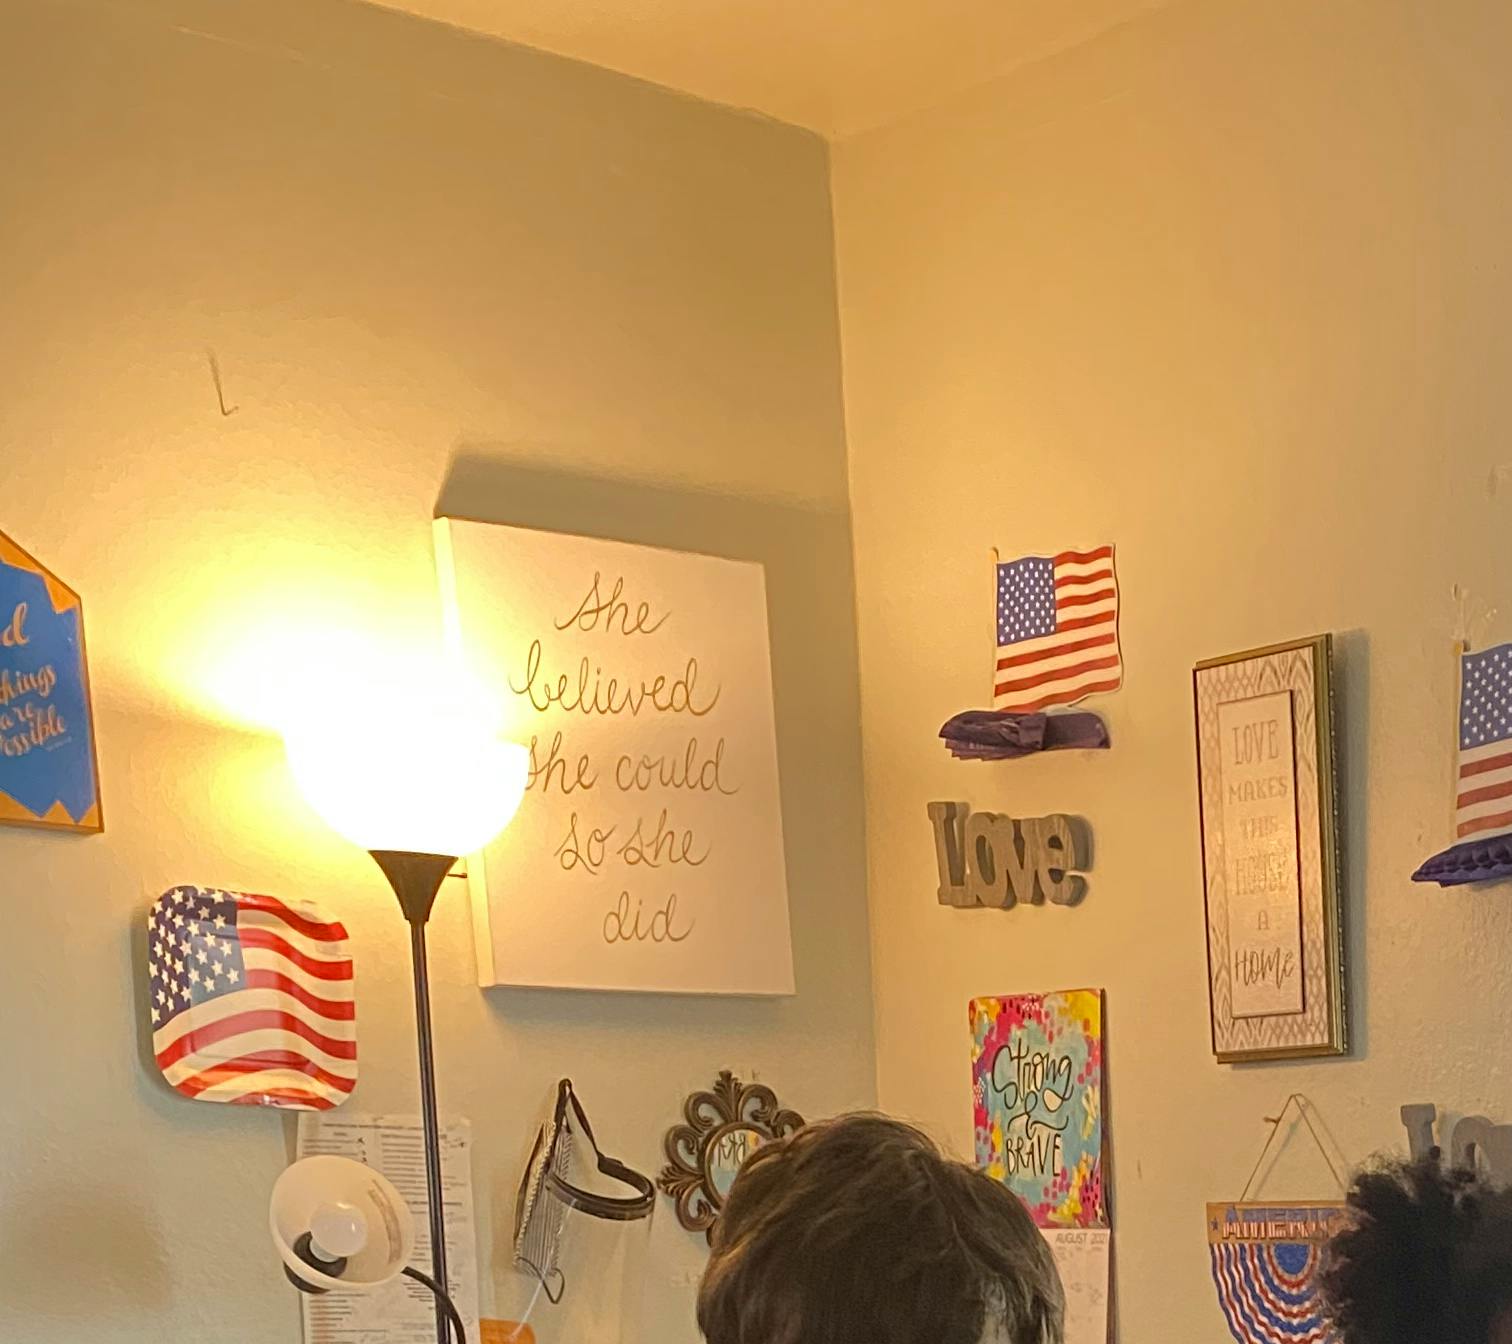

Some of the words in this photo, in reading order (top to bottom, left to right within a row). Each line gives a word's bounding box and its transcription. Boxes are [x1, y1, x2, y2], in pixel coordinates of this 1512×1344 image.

[0, 602, 30, 647] d
[0, 664, 56, 704] hings
[509, 639, 721, 717] believed
[0, 704, 66, 757] ossible
[1231, 719, 1280, 765] LOVE
[615, 736, 741, 795] could
[1228, 775, 1289, 804] MAKES
[602, 891, 696, 944] did
[1257, 909, 1270, 932] A
[992, 1038, 1074, 1113] Strong
[1006, 1133, 1062, 1177] BRAVE
[1055, 1232, 1088, 1245] AUGUST
